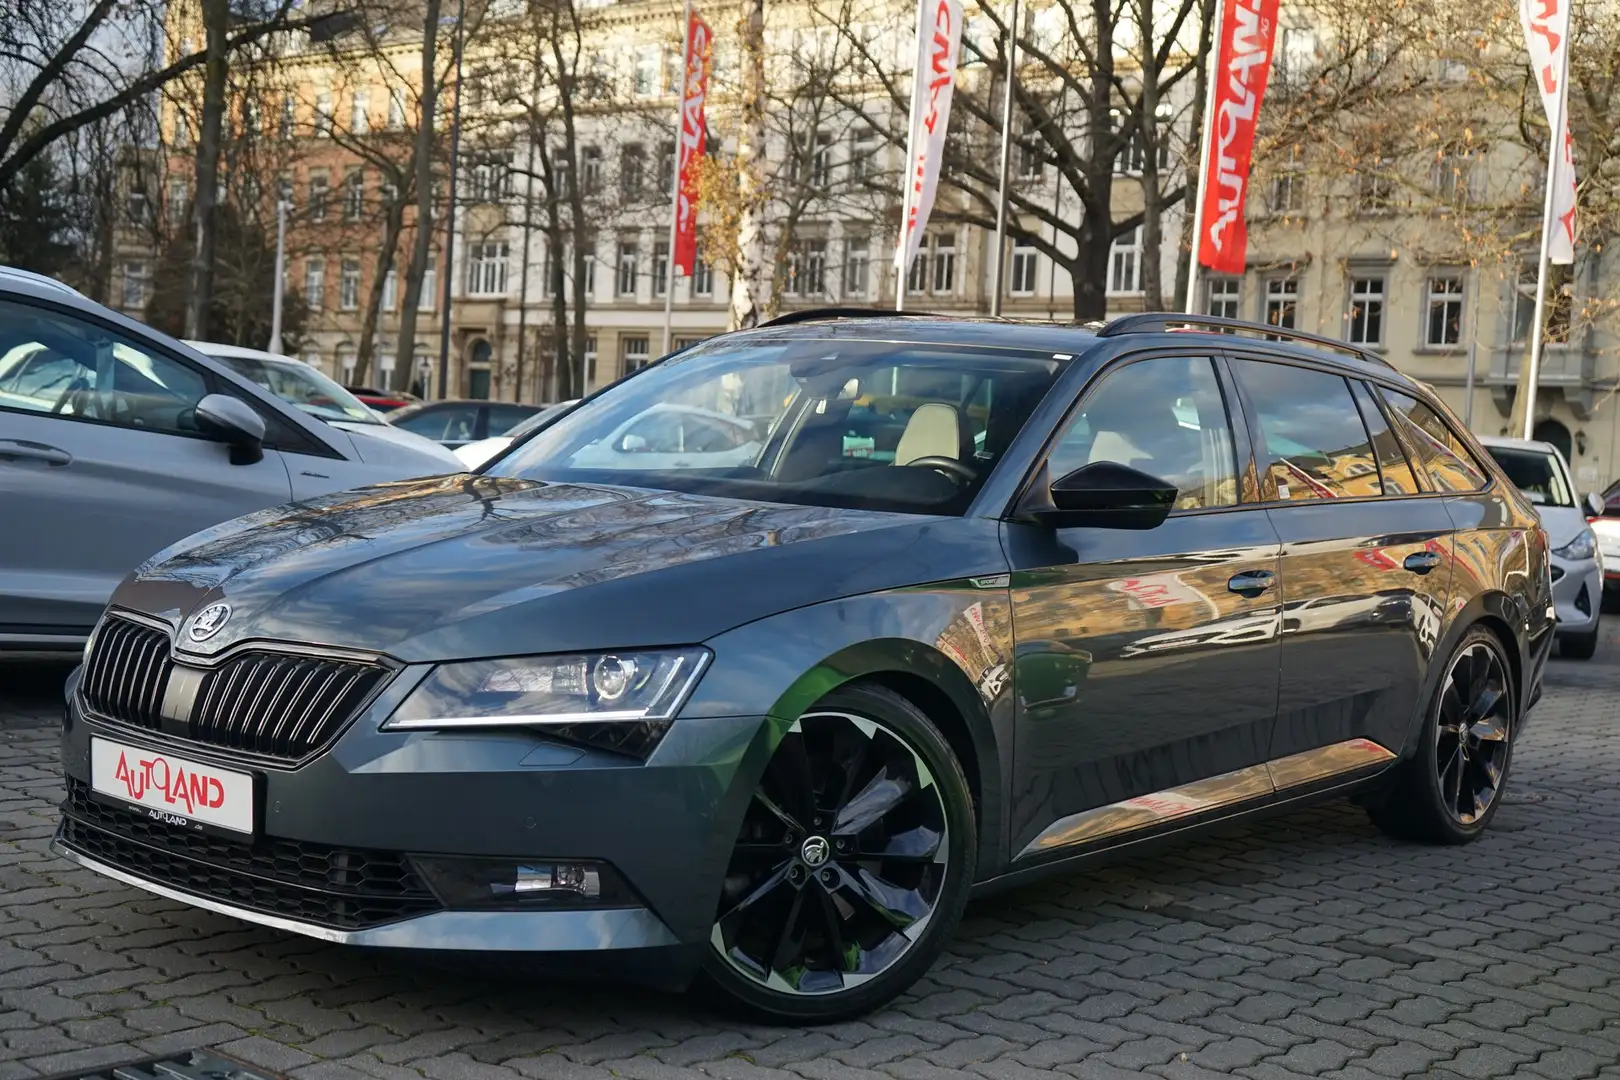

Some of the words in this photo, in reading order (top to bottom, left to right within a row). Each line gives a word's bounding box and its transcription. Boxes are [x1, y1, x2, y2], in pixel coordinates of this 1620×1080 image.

[1261, 17, 1271, 39] AG
[1209, 0, 1268, 252] AUTOLAN
[115, 749, 225, 814] AUTOLAND
[148, 809, 187, 826] AUTOLAND
